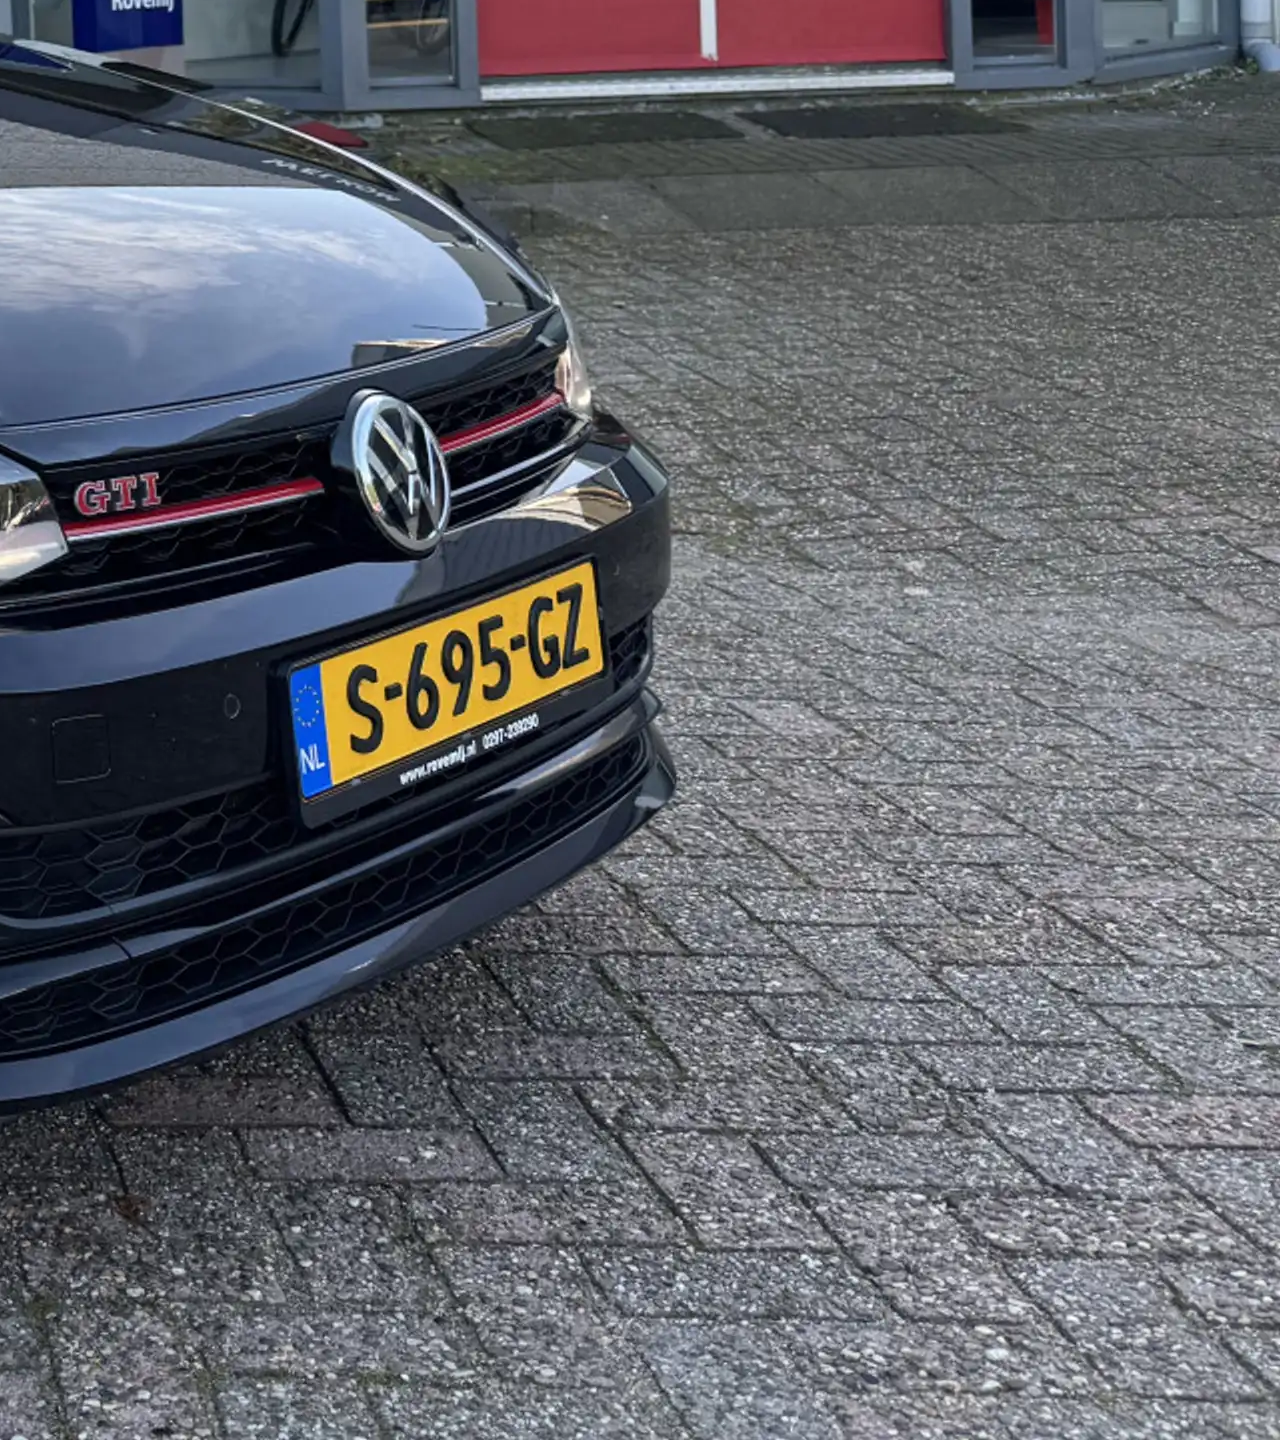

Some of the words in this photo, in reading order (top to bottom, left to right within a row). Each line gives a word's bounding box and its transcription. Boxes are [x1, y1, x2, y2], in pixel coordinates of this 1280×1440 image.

[73, 471, 162, 518] GTI
[346, 582, 590, 754] S-695-GZ
[299, 743, 325, 775] NL
